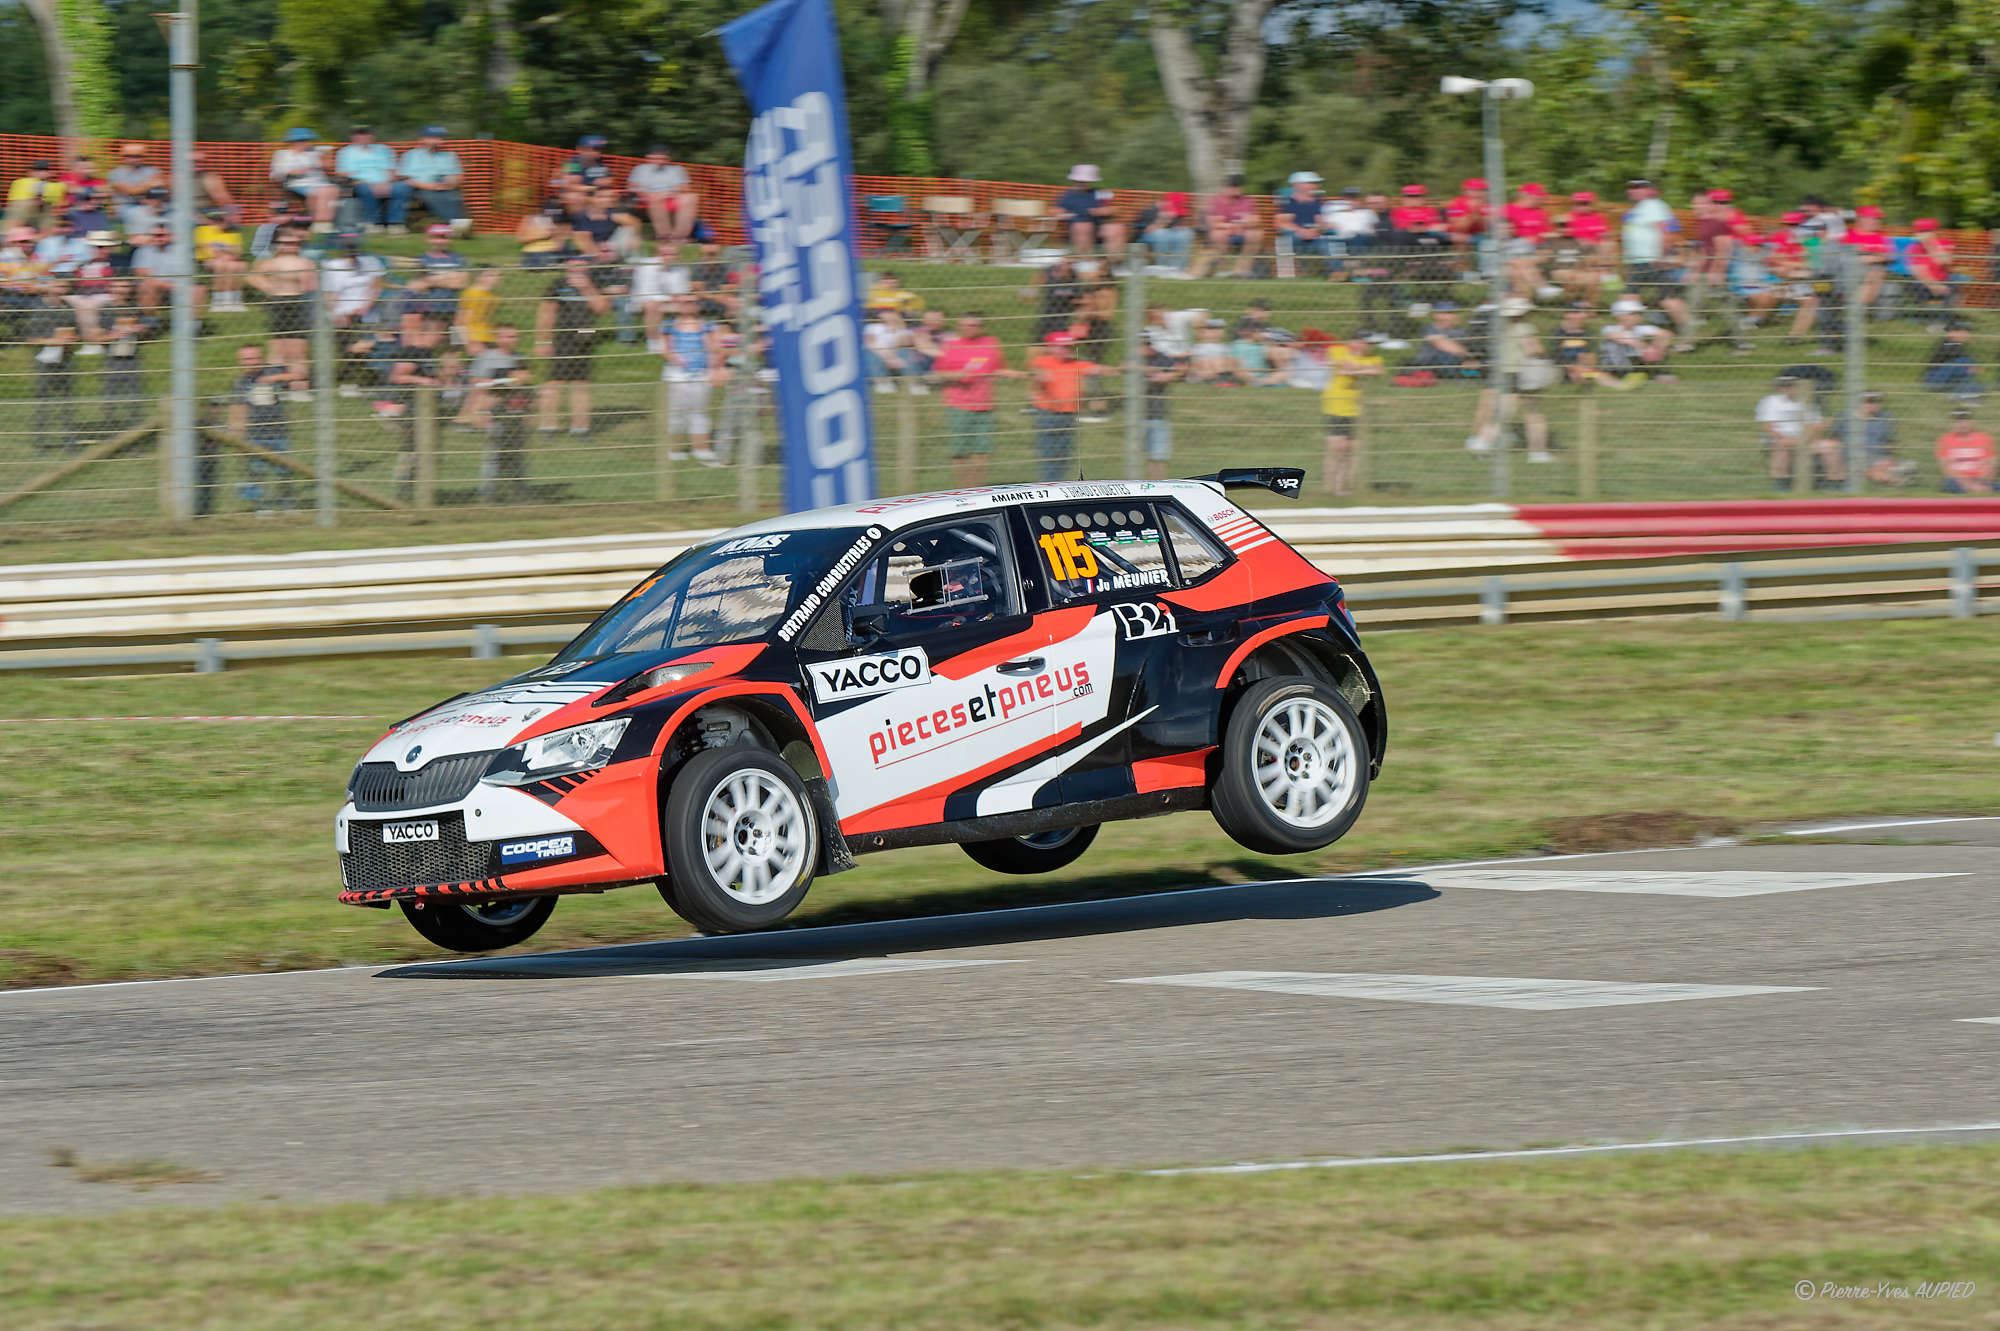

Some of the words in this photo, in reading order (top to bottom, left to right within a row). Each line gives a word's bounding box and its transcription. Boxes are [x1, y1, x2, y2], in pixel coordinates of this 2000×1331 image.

[991, 491, 1034, 503] AMIANTE
[1036, 489, 1049, 499] 37
[1213, 507, 1235, 521] BOSCH
[1038, 530, 1099, 581] 115
[777, 593, 821, 642] BERTRAND
[815, 535, 873, 598] COMBUSTIBLES
[1096, 578, 1110, 592] Ju
[1112, 568, 1172, 590] MEUNIER
[819, 655, 921, 692] YACCO
[868, 661, 1090, 764] piecesetpneus
[388, 822, 433, 840] YACCO
[502, 836, 573, 856] COOPER
[535, 846, 573, 859] TIRES
